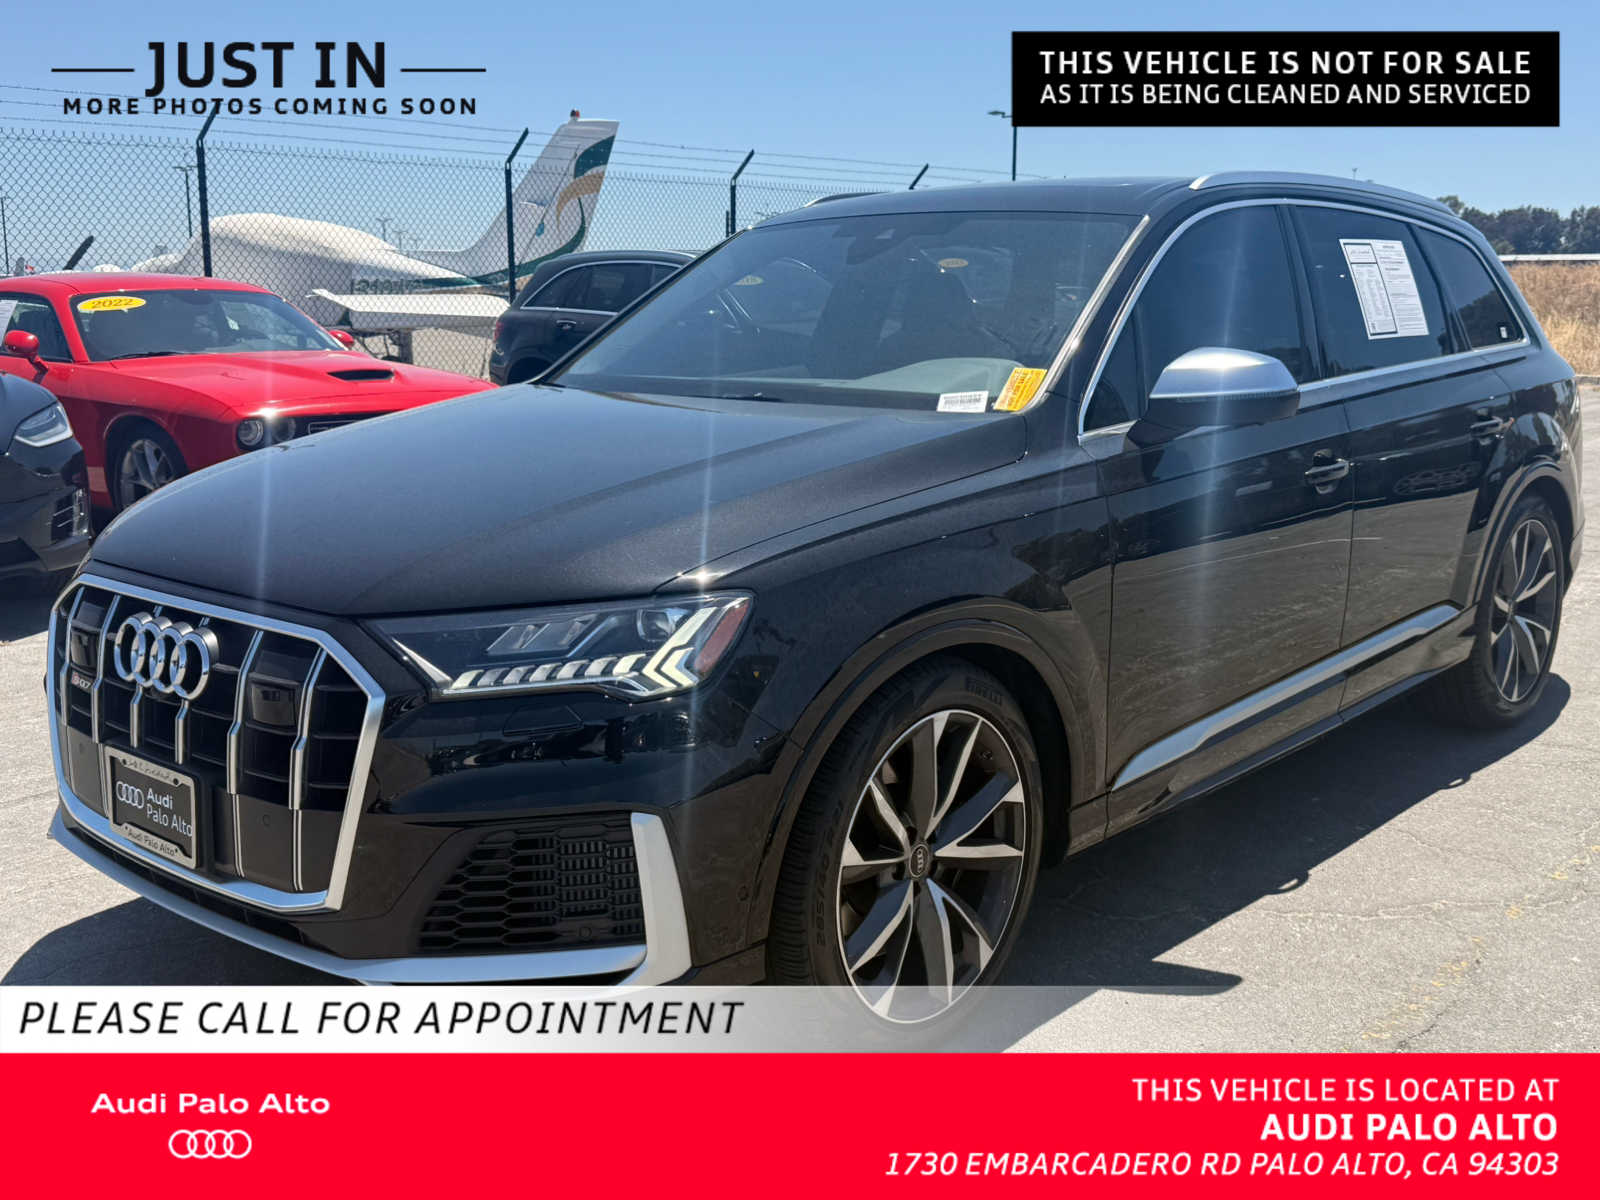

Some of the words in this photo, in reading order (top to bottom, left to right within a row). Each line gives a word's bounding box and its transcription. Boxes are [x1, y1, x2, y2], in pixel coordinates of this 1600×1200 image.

[147, 788, 173, 810] Audi
[147, 804, 169, 827] Palo
[171, 816, 193, 837] Alto
